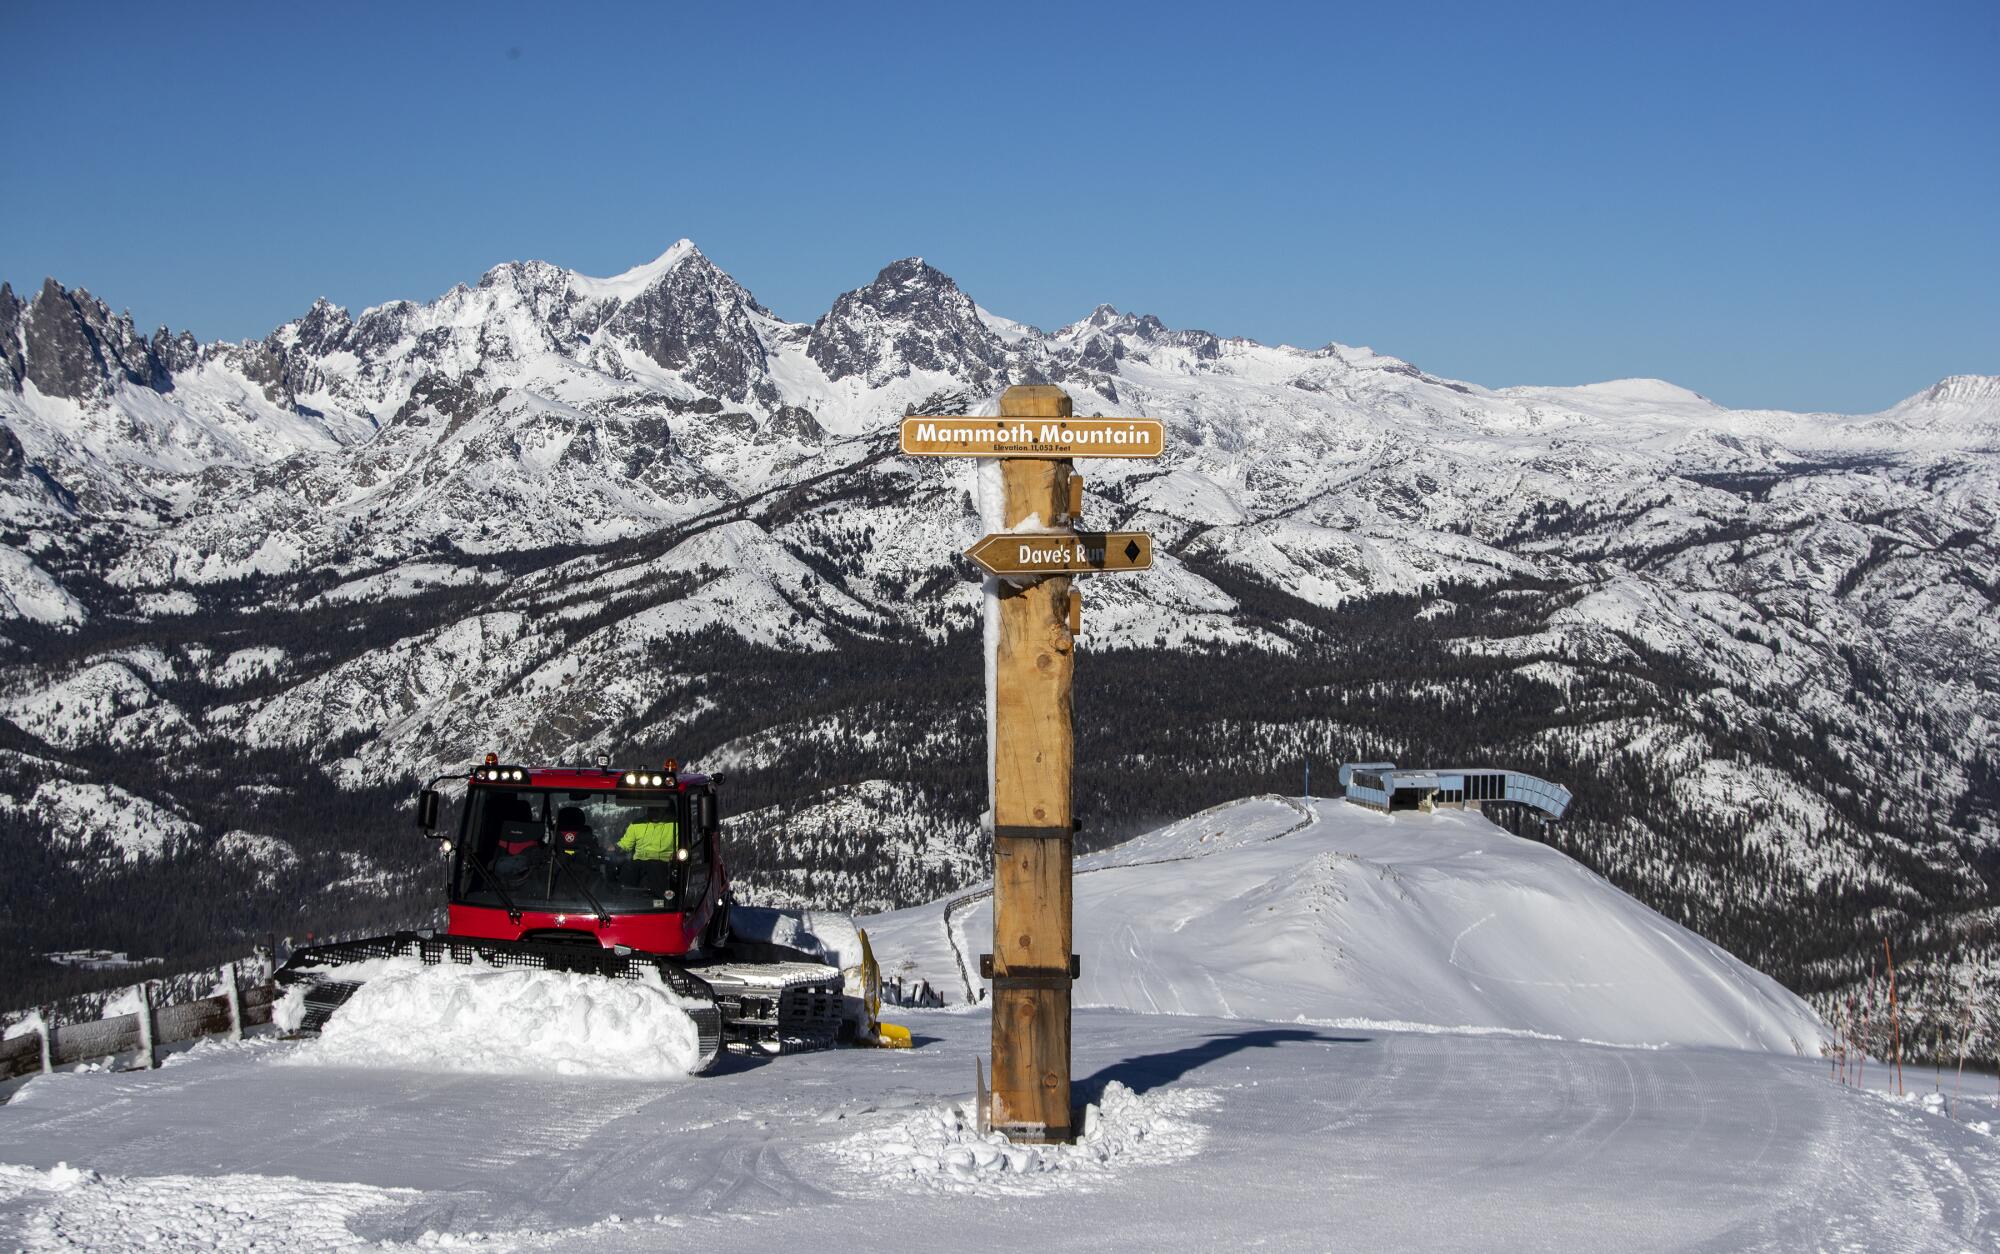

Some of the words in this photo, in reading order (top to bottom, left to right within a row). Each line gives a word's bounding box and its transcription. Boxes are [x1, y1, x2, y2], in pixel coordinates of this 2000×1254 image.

[916, 423, 1033, 442] Mammoth
[1039, 424, 1150, 444] Mountain
[1019, 544, 1071, 564] Dave's
[1076, 544, 1105, 563] Run
